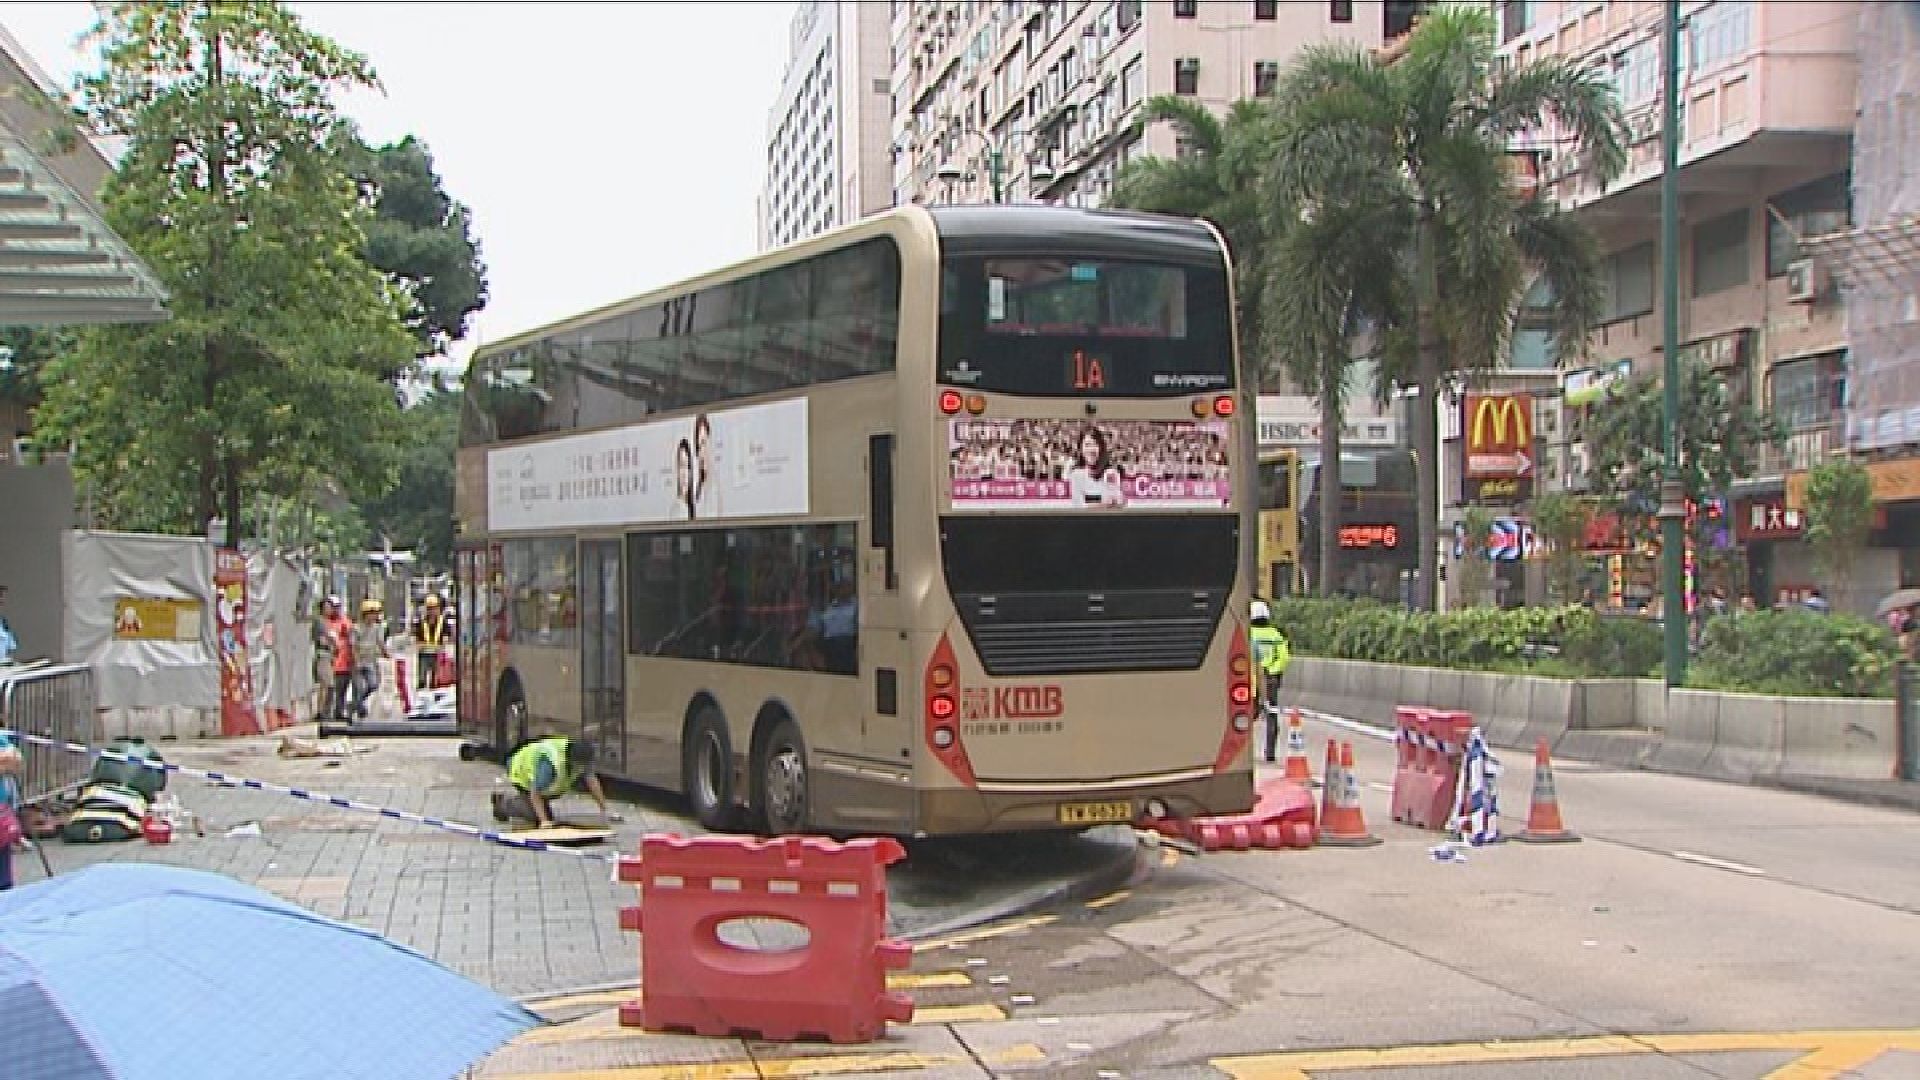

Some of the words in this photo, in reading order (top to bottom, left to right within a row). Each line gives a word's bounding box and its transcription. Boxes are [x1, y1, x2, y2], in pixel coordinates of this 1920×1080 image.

[1072, 349, 1105, 388] 1A
[1261, 422, 1309, 440] HSBC
[994, 686, 1064, 719] KMB
